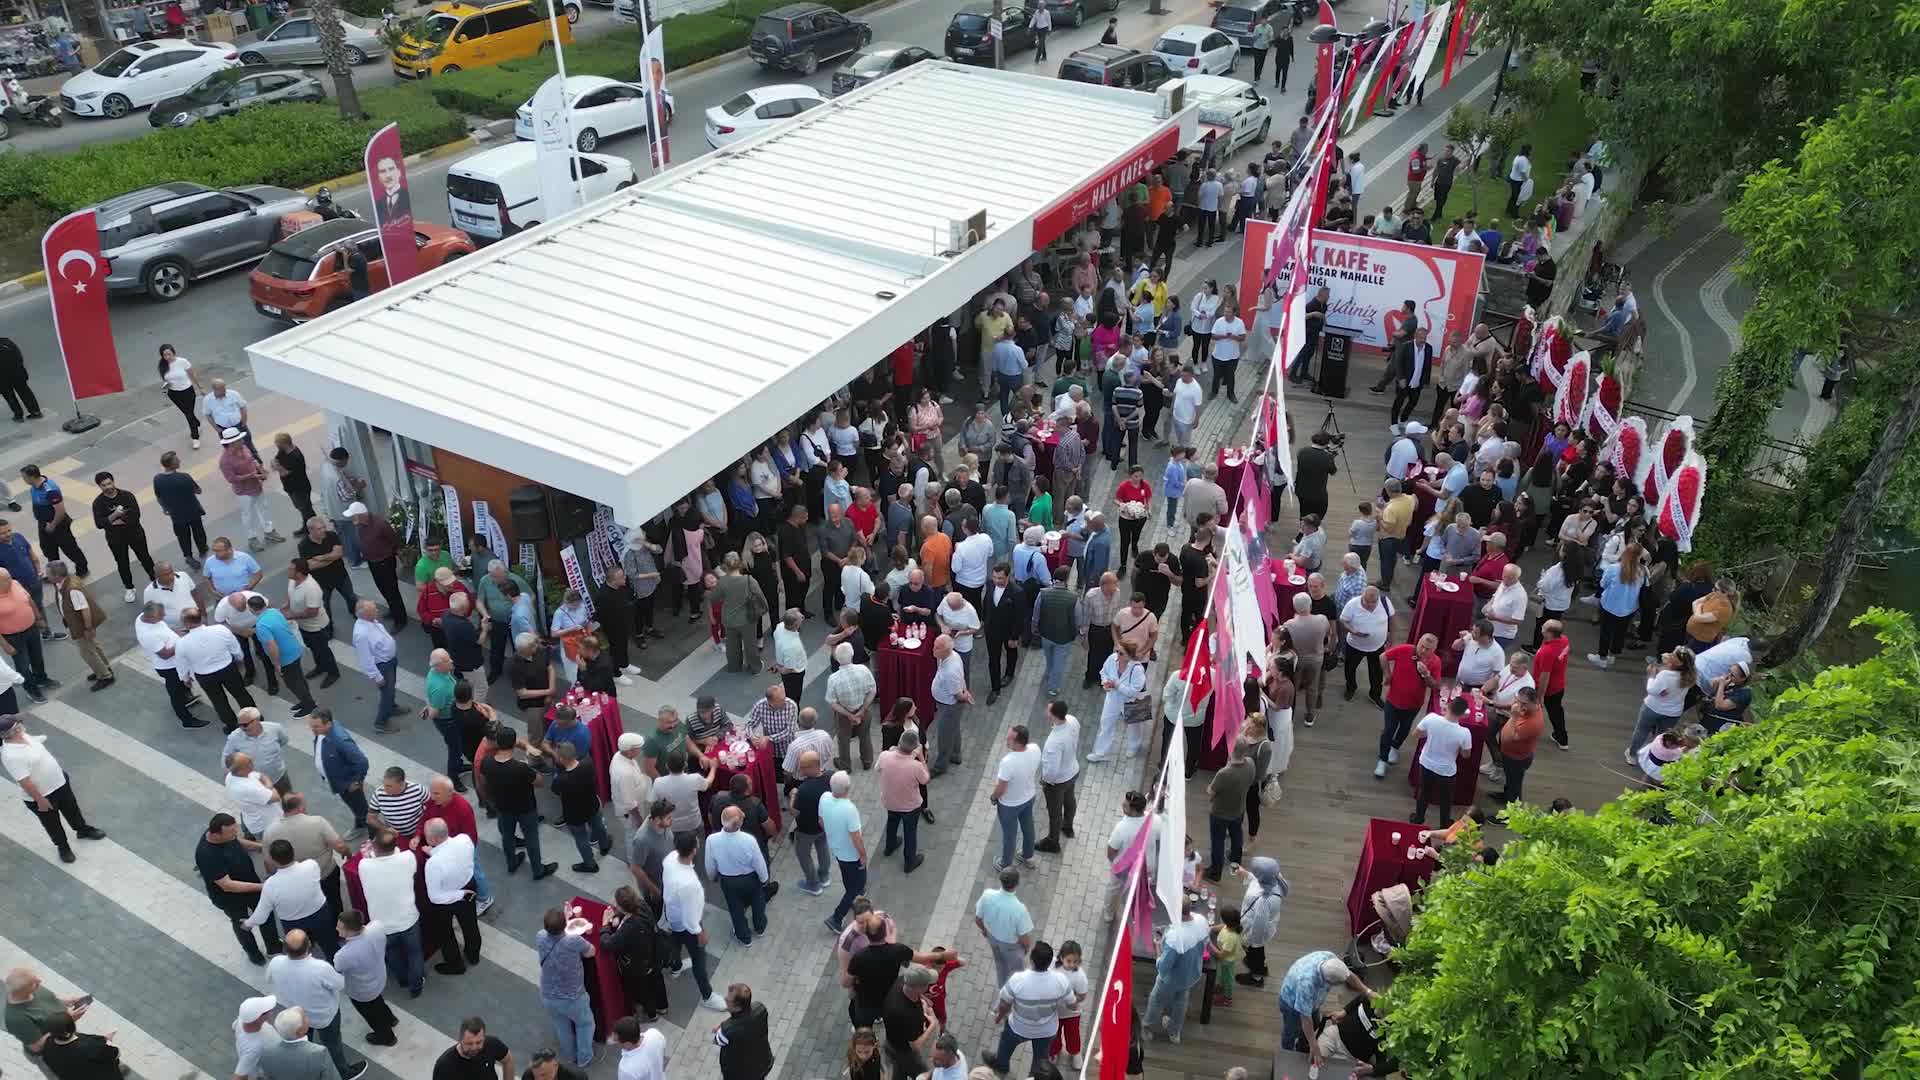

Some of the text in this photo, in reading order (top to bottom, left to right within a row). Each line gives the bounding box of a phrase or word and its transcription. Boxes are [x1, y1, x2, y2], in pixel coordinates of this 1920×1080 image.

[1092, 175, 1118, 208] HALK
[1120, 158, 1144, 188] KAFE
[1324, 248, 1369, 271] KAFE
[1373, 263, 1387, 274] ve
[1340, 270, 1385, 286] MAHALLE
[1326, 296, 1378, 326] eldiniz
